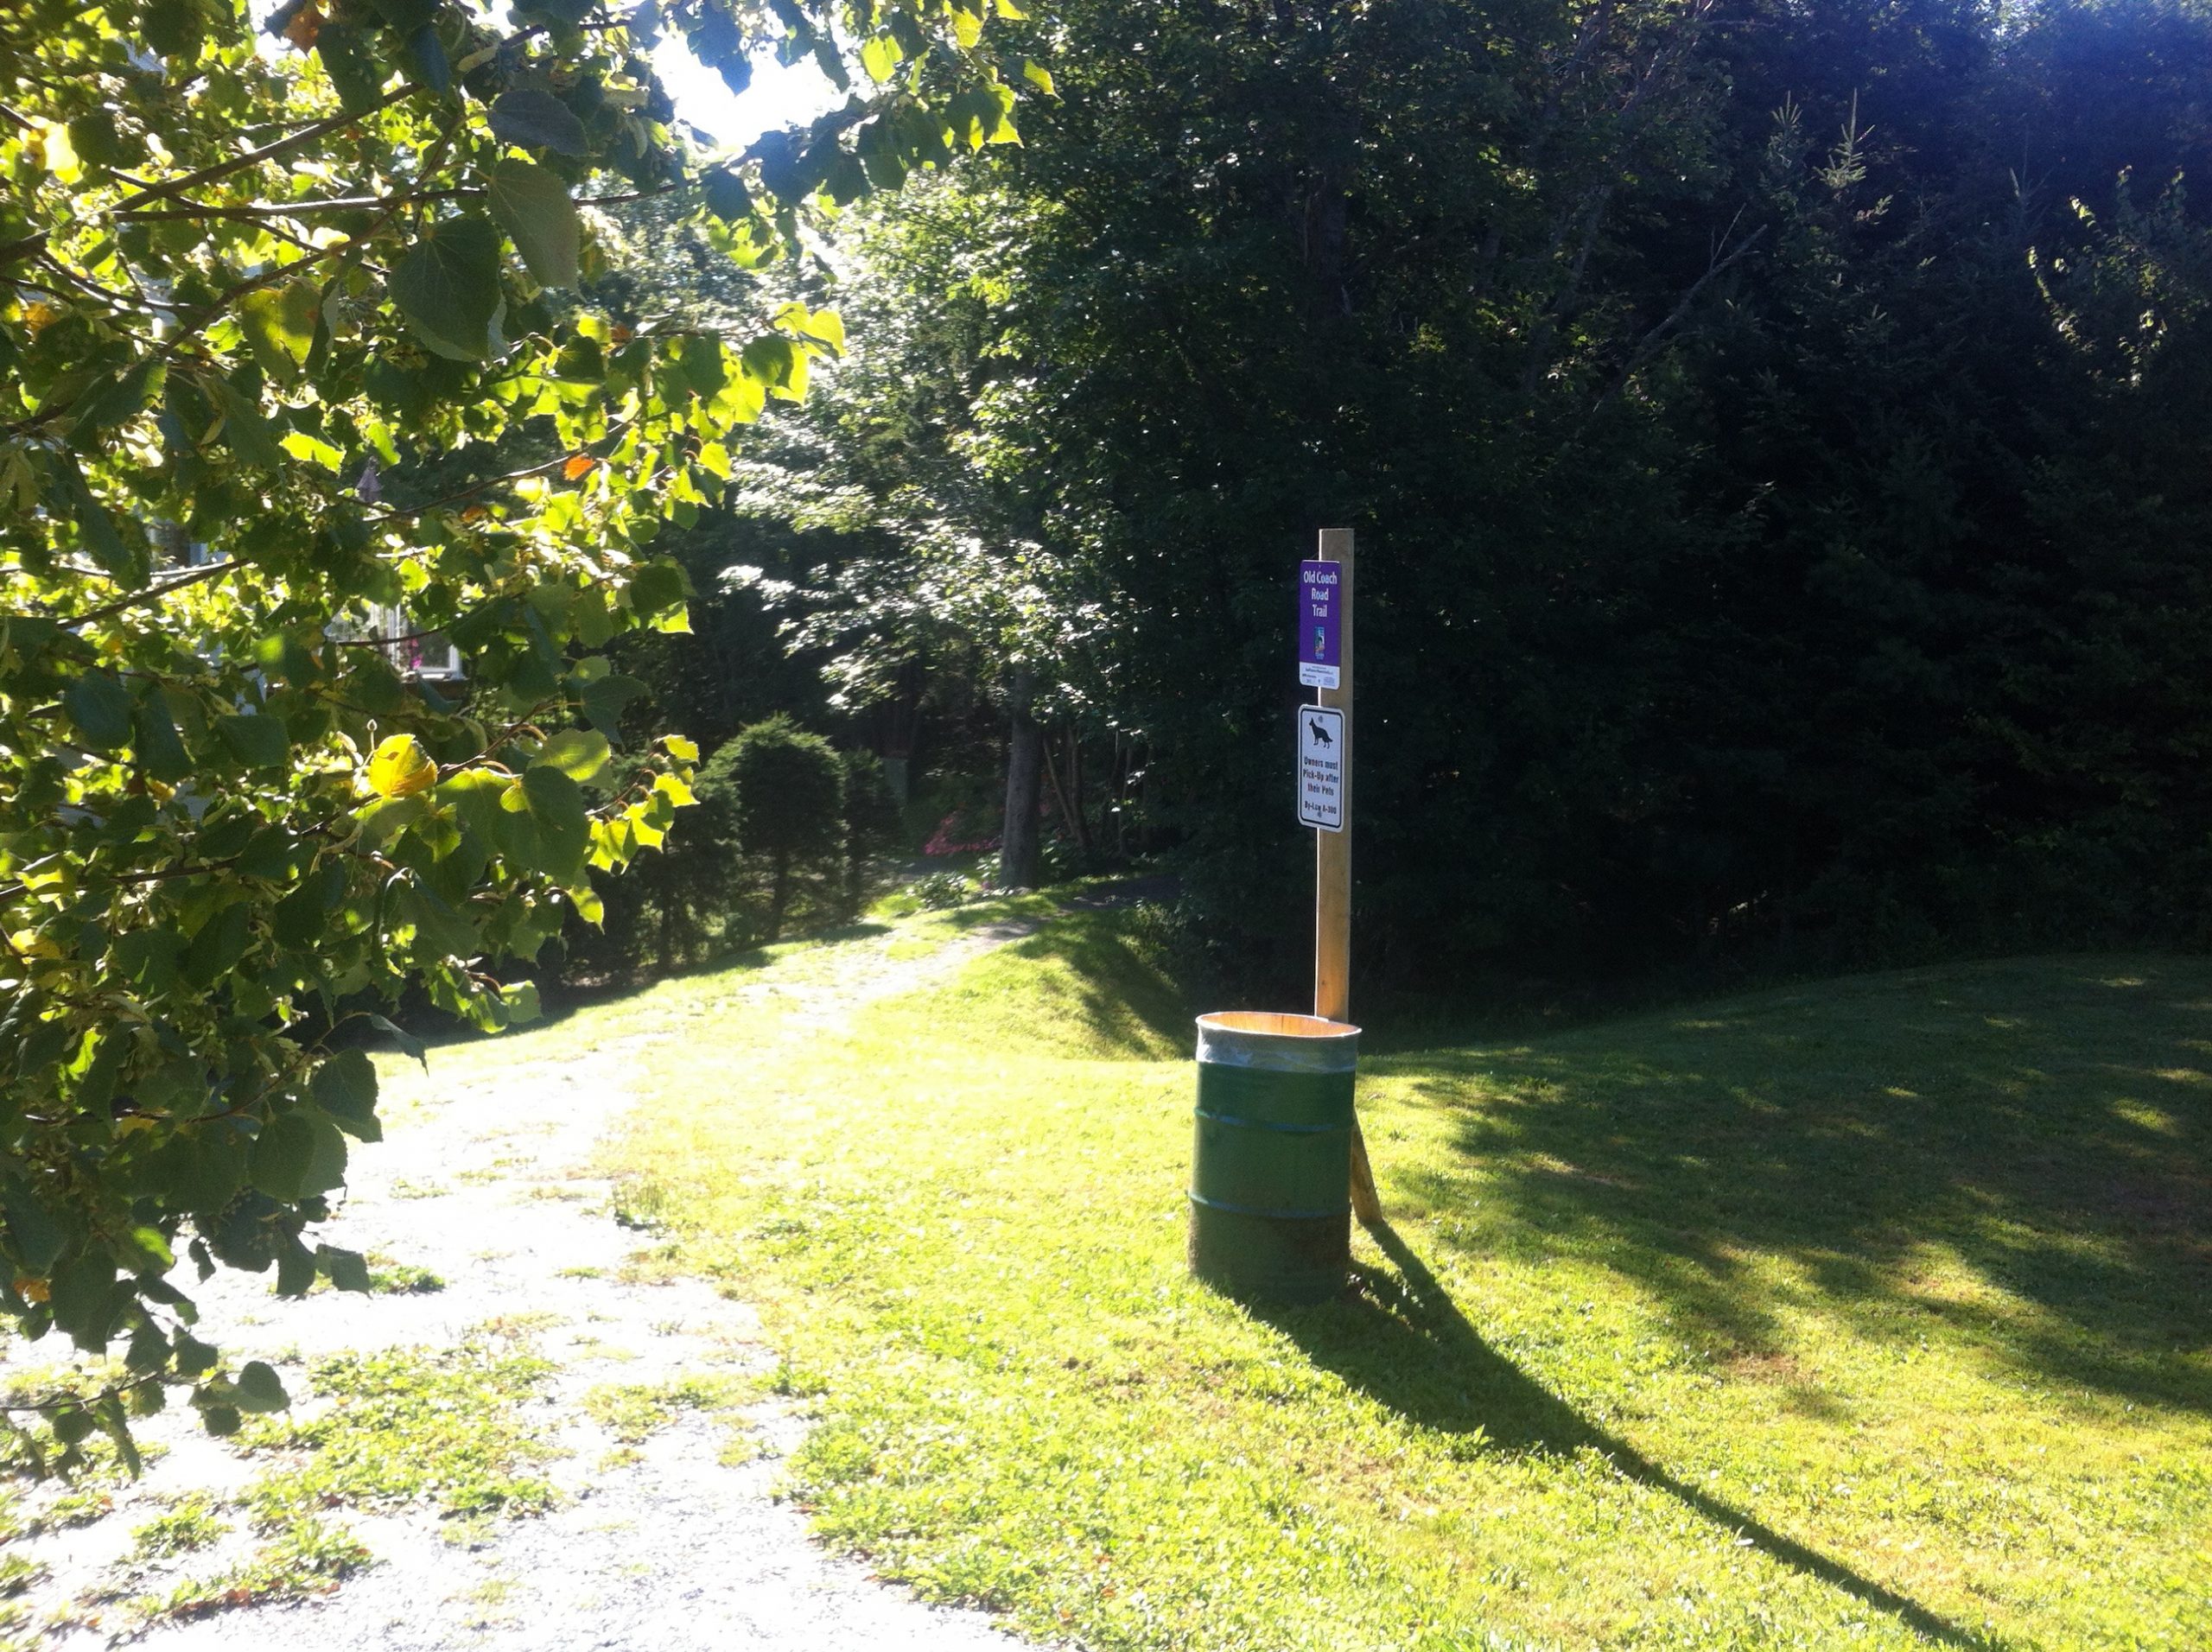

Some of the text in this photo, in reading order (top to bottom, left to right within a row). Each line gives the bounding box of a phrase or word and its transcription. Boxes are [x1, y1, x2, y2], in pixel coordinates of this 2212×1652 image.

[1303, 570, 1338, 585] Old Coach
[1311, 588, 1329, 600] Road
[1312, 604, 1328, 618] Trail
[1304, 756, 1338, 770] Owners must
[1303, 768, 1338, 784] Pick-Up after
[1307, 782, 1334, 796] their Pets
